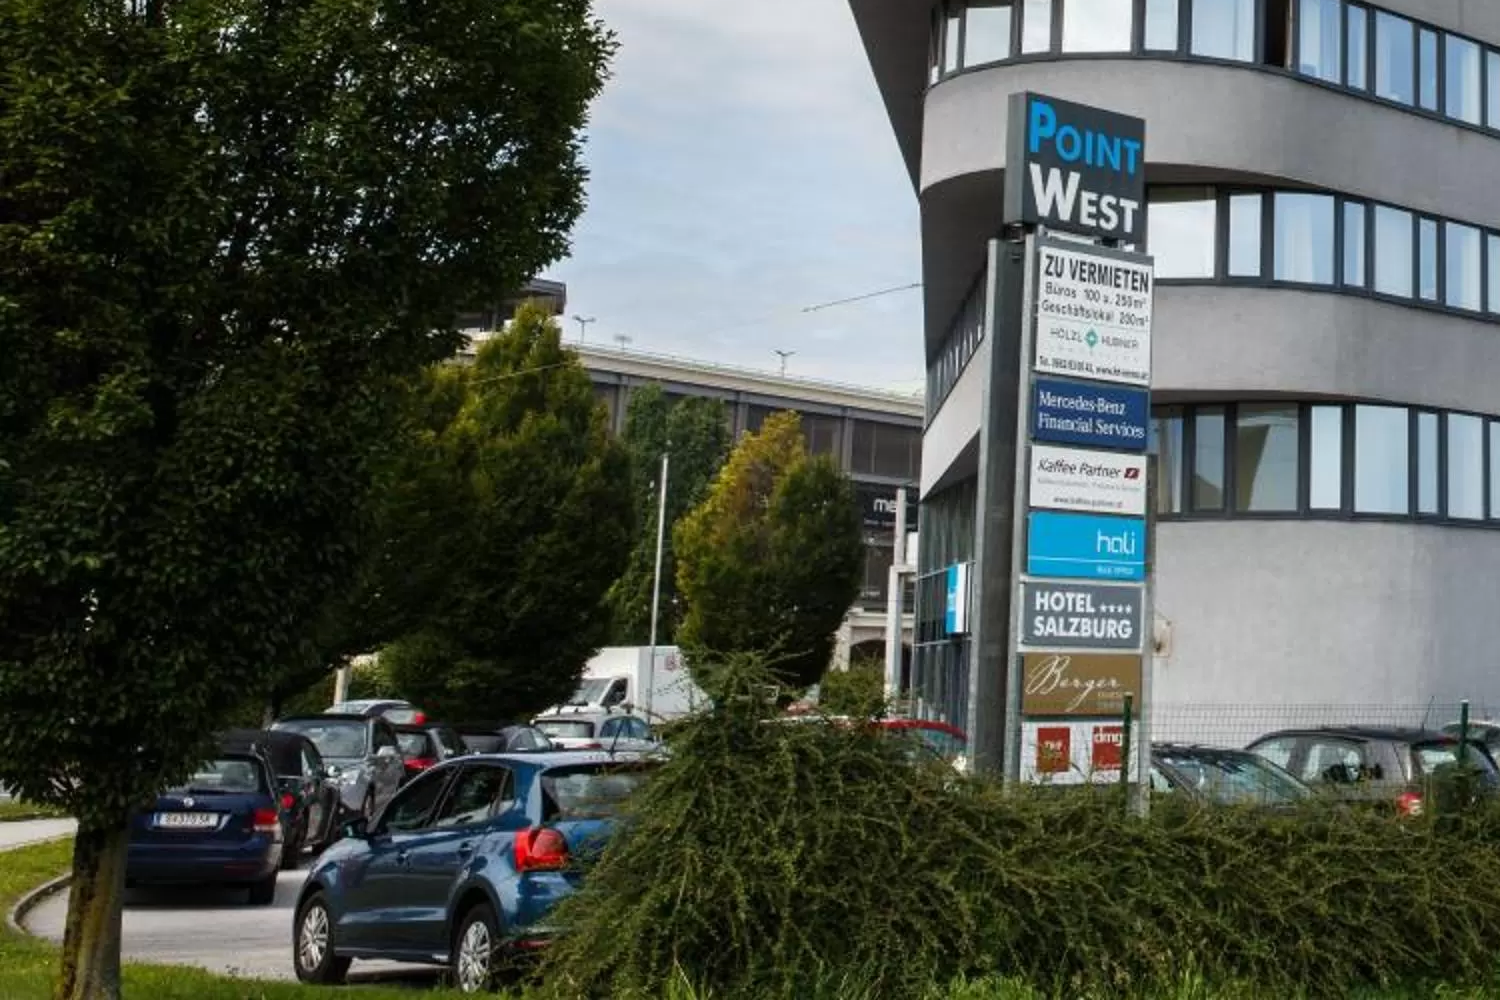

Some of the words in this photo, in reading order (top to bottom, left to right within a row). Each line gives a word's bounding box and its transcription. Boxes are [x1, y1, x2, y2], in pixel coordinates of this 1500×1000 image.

[1029, 100, 1141, 175] POINT
[1029, 163, 1139, 233] WEST
[1045, 254, 1065, 279] ZU
[1070, 258, 1149, 293] VERMIETEN
[1038, 411, 1093, 433] Financial
[1095, 419, 1145, 439] Services
[1037, 458, 1077, 475] Kaffee
[1079, 461, 1122, 478] Partner
[1035, 591, 1096, 613] HOTEL
[1033, 615, 1133, 639] SALZBURG
[1025, 655, 1123, 713] Berger
